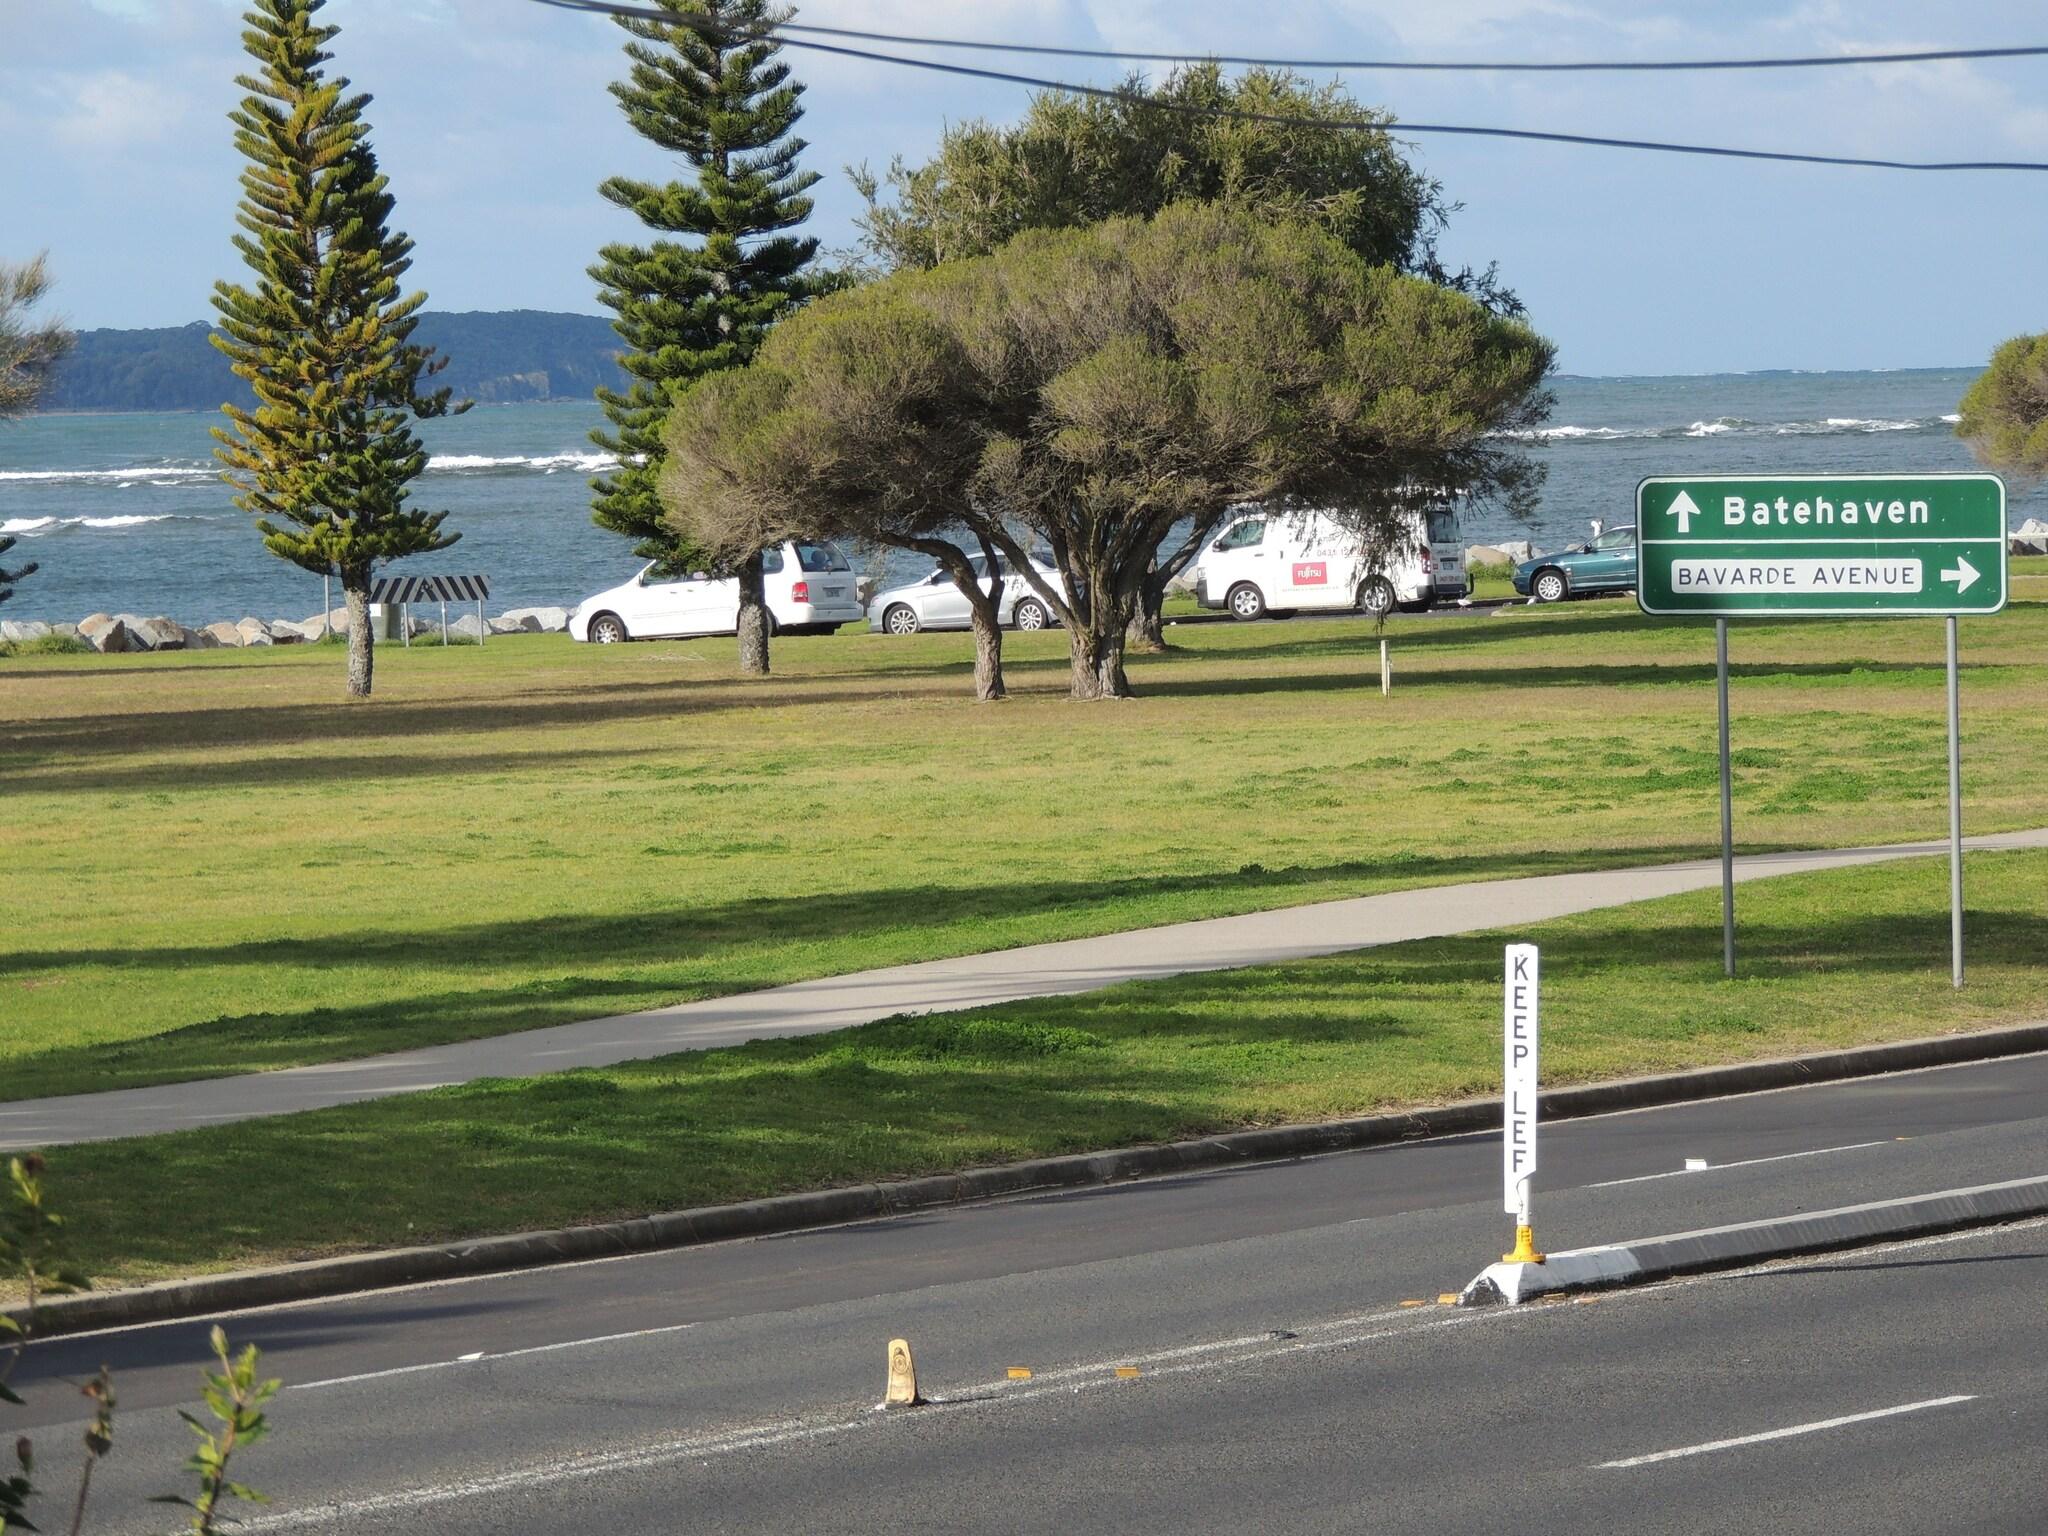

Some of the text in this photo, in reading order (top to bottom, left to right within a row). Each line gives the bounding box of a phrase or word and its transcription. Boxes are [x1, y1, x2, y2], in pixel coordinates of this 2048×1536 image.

[1723, 495, 1928, 526] Batehaven
[1678, 567, 1915, 586] BAVARDE AVENUE
[1513, 956, 1529, 1069] KEEP
